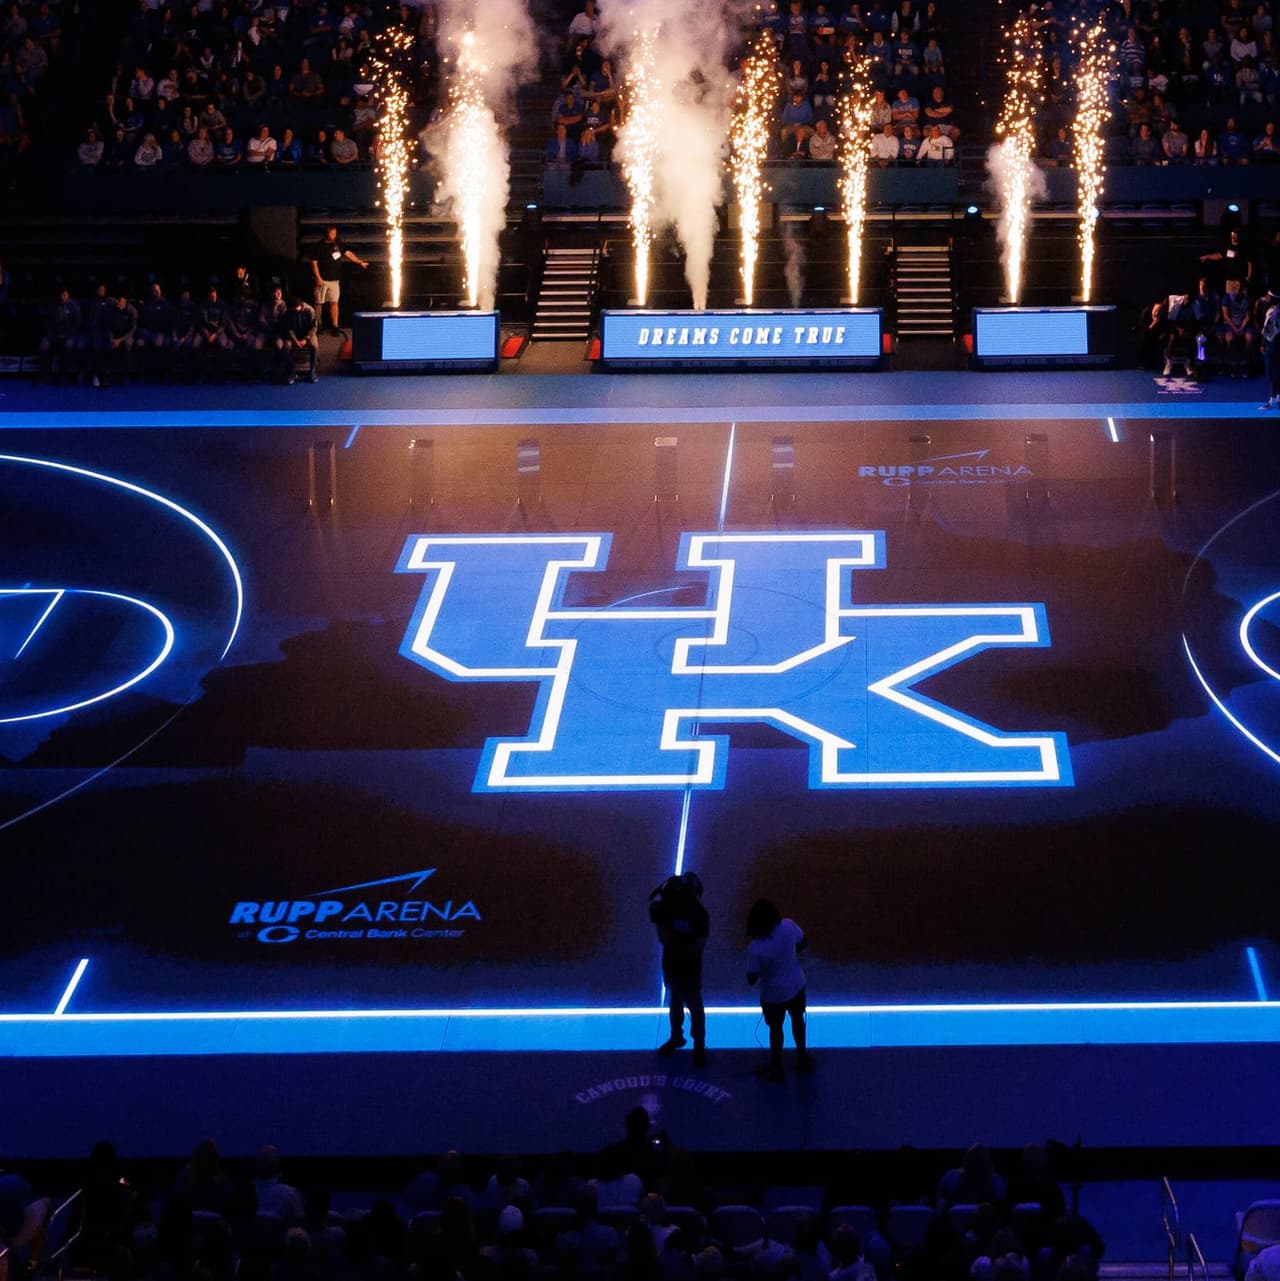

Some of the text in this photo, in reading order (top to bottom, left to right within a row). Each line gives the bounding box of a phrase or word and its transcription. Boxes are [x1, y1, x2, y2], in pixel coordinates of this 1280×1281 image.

[638, 326, 846, 345] DREAMS COME TRUE
[857, 465, 1035, 478] RUPP ARENA
[229, 900, 482, 924] RUPP ARENA
[304, 928, 364, 939] Central
[366, 928, 407, 938] Bank
[410, 927, 465, 938] Center
